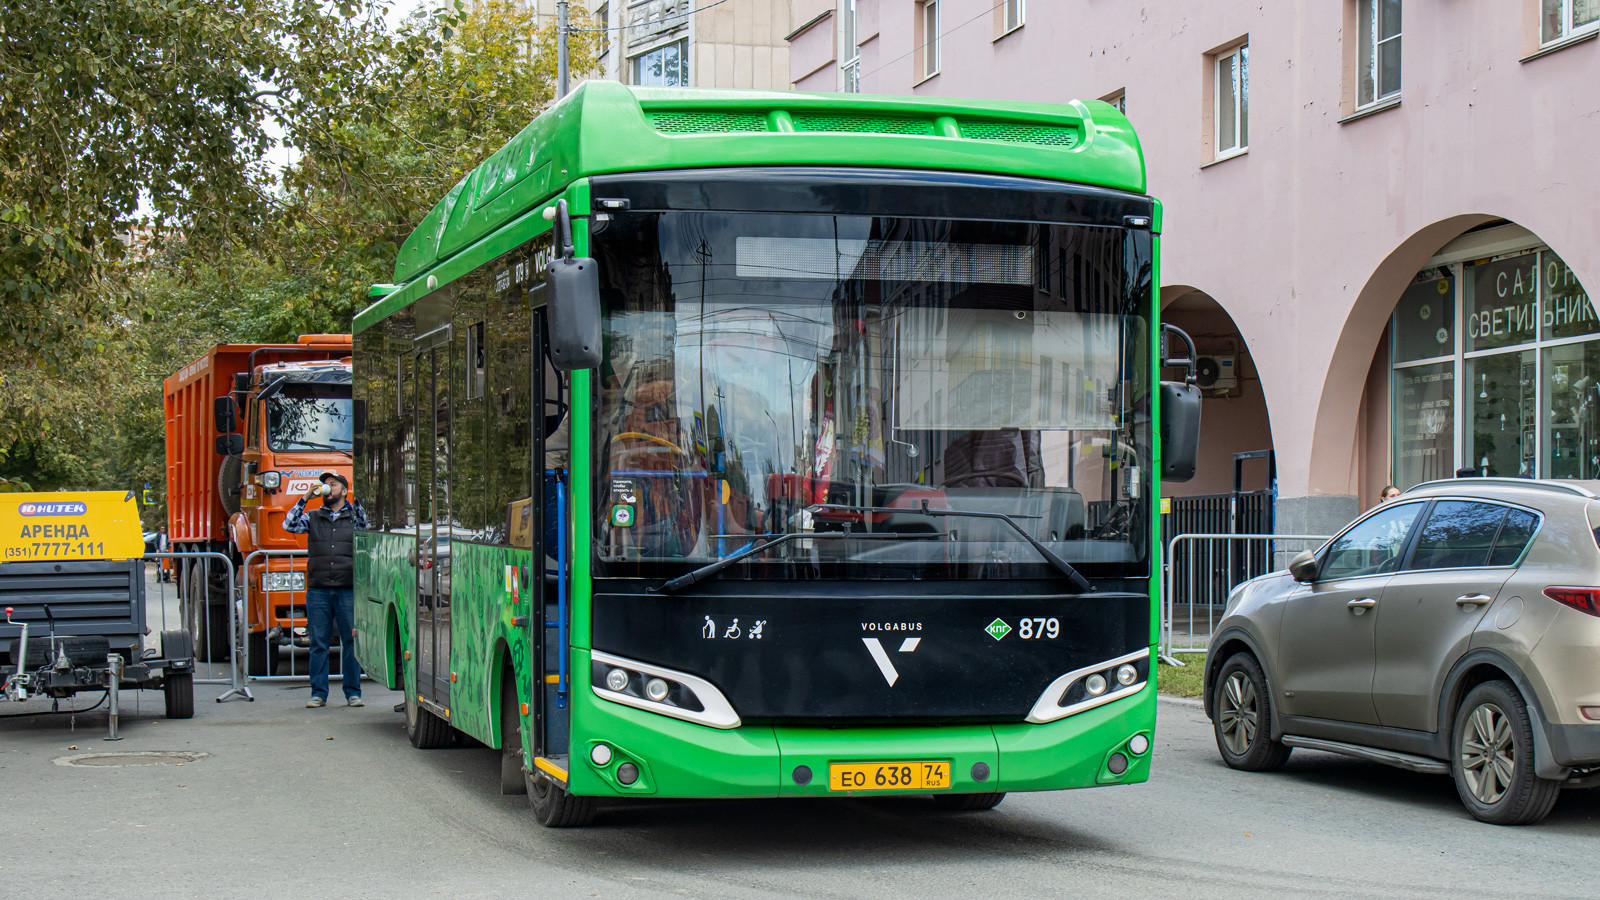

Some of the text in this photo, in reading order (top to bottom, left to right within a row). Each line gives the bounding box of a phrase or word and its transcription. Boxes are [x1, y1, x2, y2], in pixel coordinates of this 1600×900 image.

[20, 524, 90, 540] АРЕНДА
[861, 622, 924, 631] VOLGABUS
[1018, 618, 1061, 639] 879
[841, 765, 943, 786] ЕО 638 74
